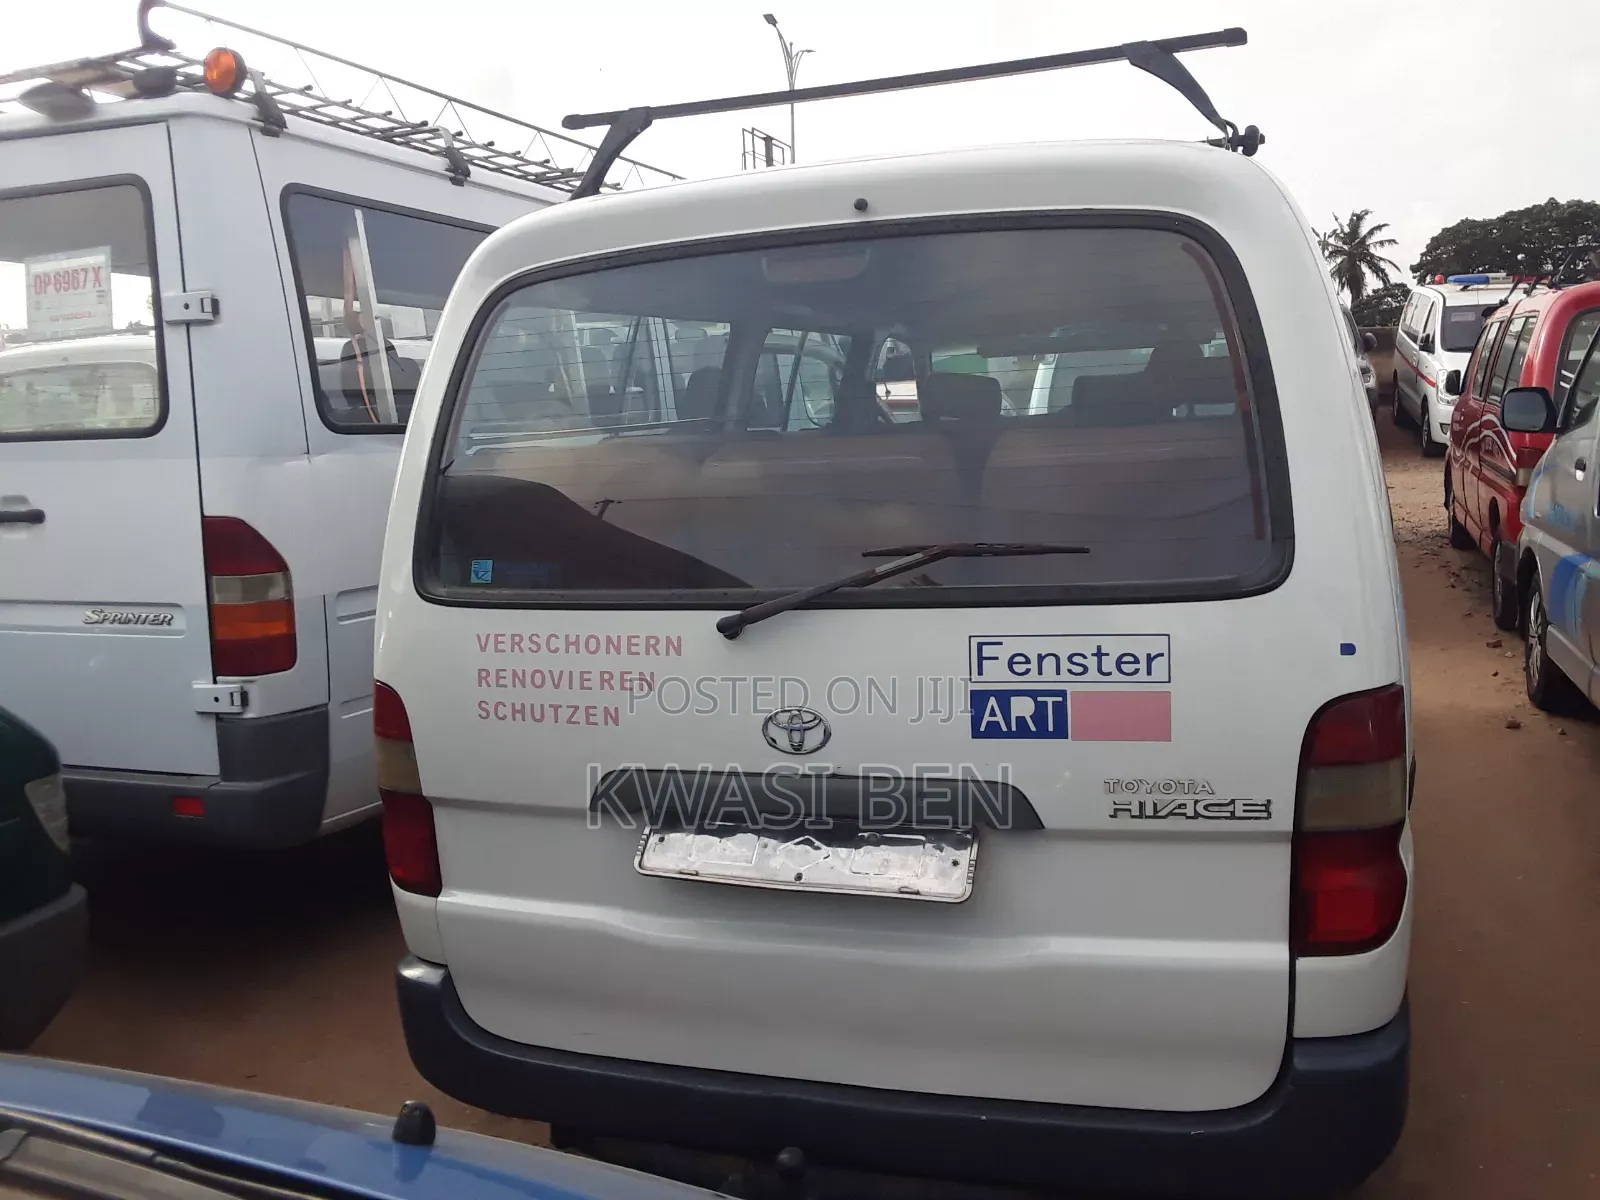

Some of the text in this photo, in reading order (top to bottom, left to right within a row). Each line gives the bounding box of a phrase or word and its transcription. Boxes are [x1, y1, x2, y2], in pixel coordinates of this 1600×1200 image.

[476, 633, 682, 656] VERSCHONERN
[975, 640, 1165, 677] Fenster
[477, 668, 656, 692] RENOVIEREN
[477, 700, 621, 727] SCHUTZEN
[978, 695, 1064, 732] ART
[1104, 778, 1215, 796] TOYOTA
[1107, 798, 1272, 820] HIACE
